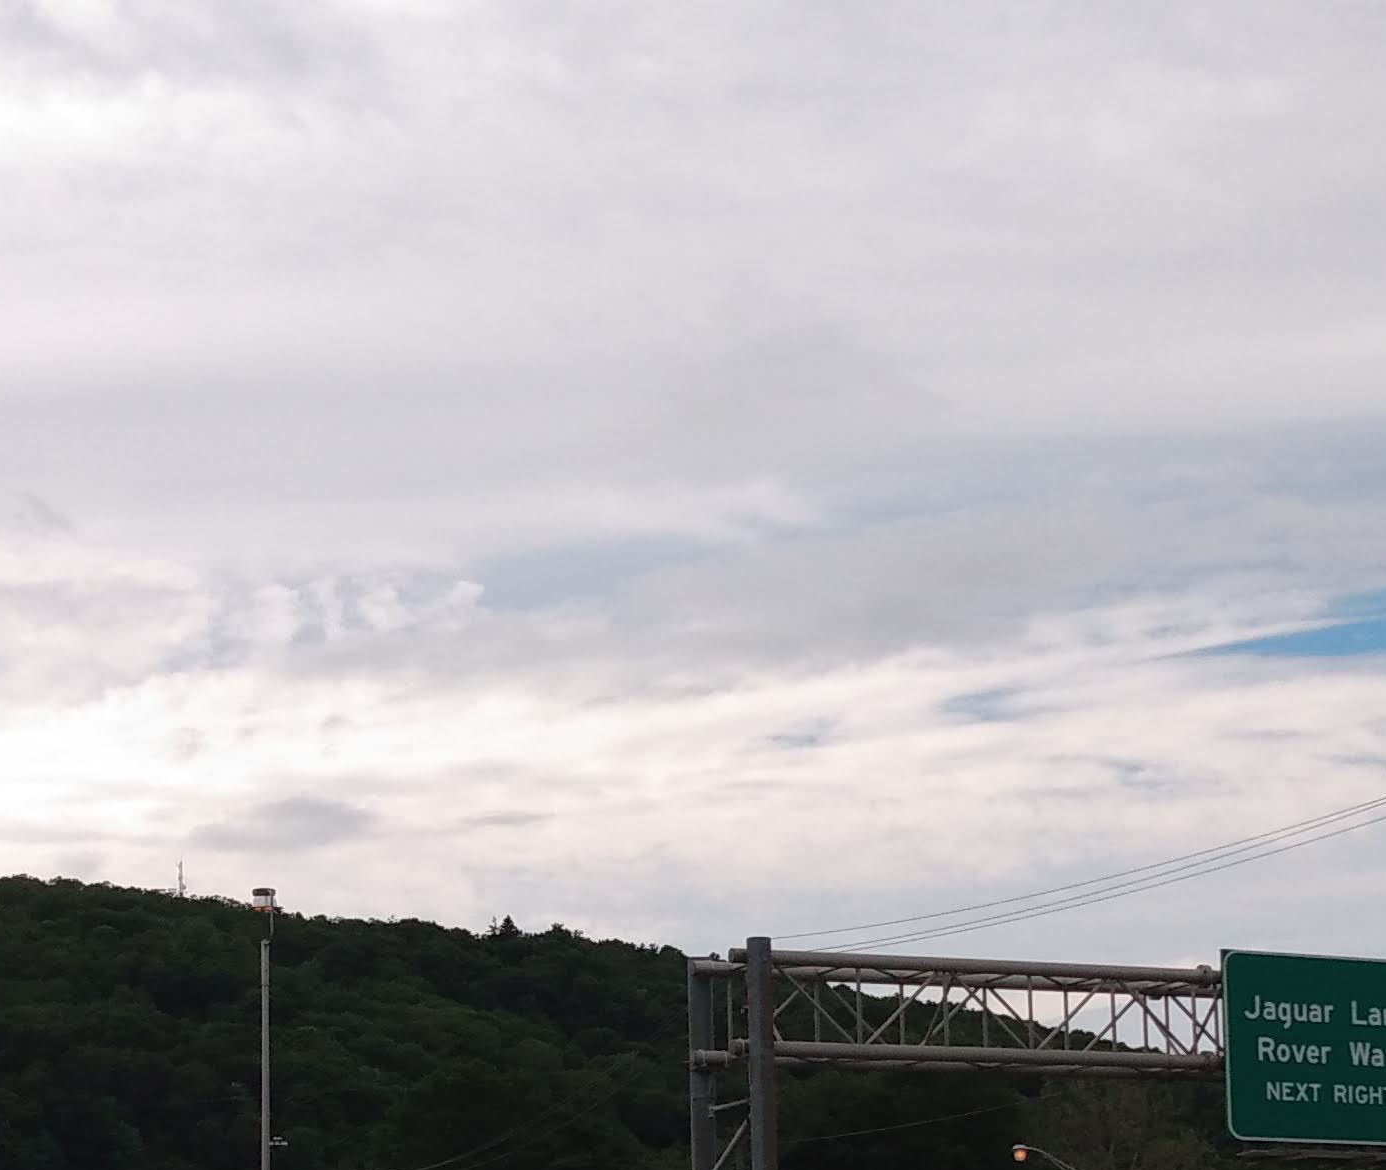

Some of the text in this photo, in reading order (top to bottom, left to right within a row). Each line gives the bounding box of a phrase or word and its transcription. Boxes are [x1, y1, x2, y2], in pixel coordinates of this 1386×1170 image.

[1243, 995, 1334, 1029] Jaguar
[1257, 1036, 1332, 1064] Rover
[1266, 1082, 1322, 1102] NEXT
